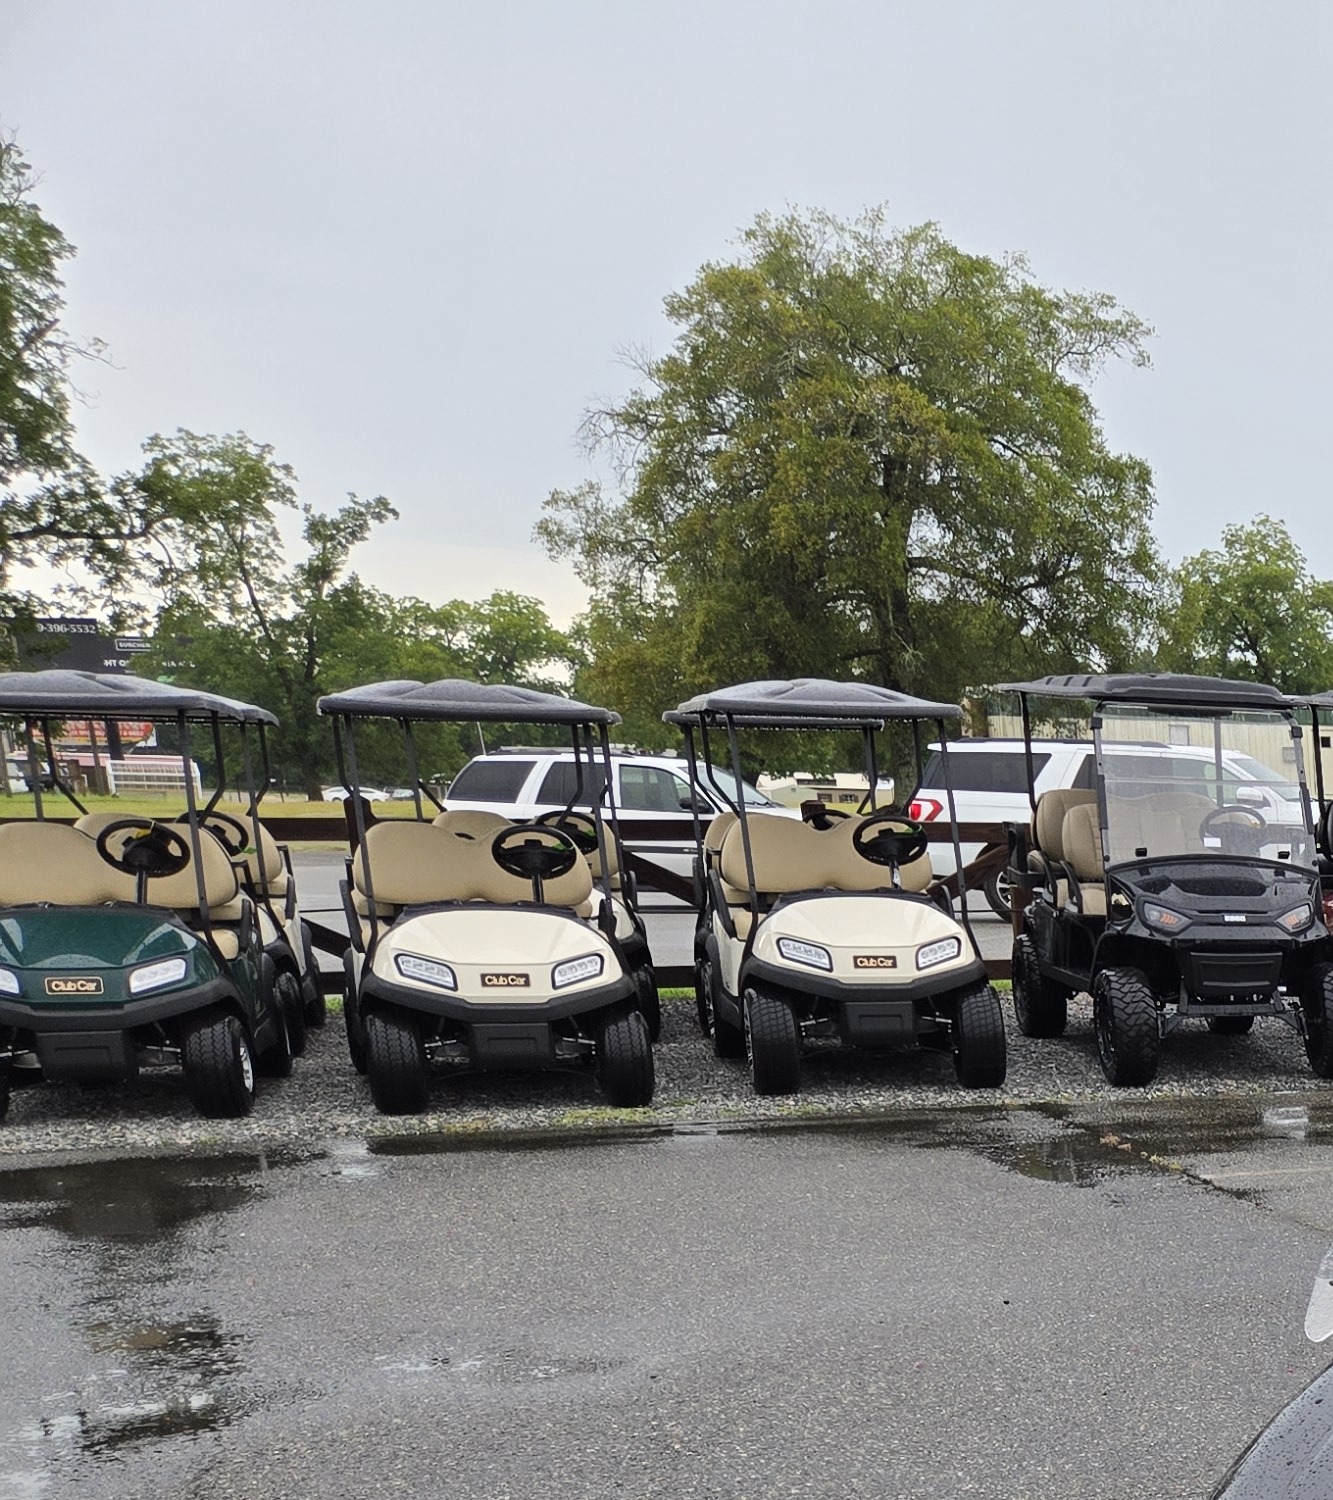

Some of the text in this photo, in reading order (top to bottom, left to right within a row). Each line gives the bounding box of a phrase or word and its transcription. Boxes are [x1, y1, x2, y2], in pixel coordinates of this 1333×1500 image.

[37, 623, 96, 634] 9-396-5532
[857, 957, 893, 967] Club Car
[485, 975, 526, 985] Club Car
[51, 980, 97, 991] Club Car
